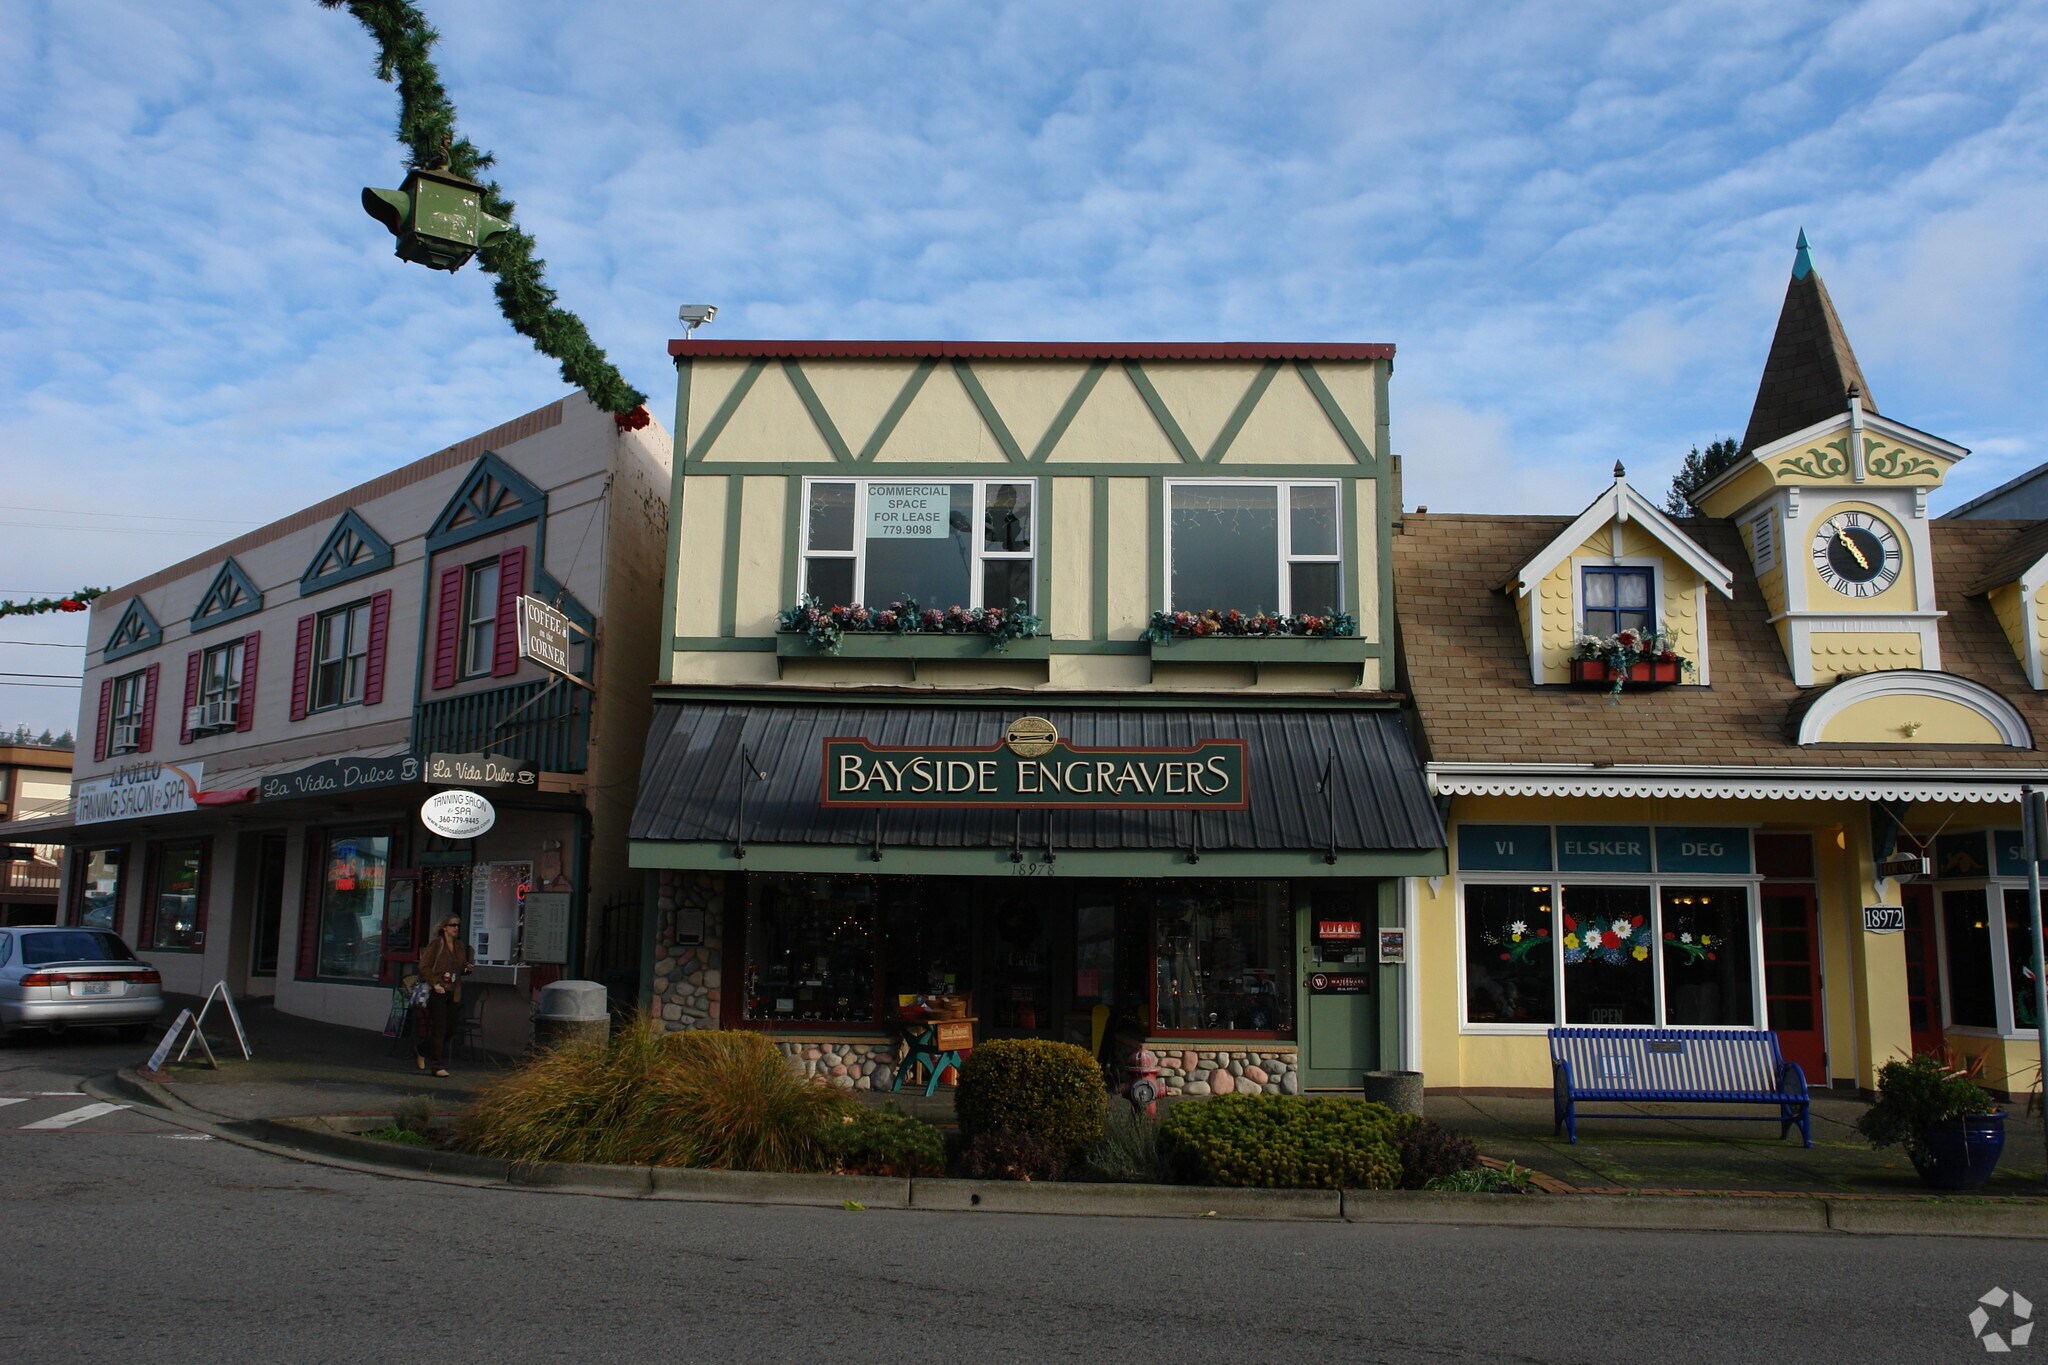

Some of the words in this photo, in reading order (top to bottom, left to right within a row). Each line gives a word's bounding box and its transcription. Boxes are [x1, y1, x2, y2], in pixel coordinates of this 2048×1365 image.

[868, 486, 948, 496] COMMERCIAL
[888, 499, 928, 509] SPACE
[874, 512, 899, 522] FOR
[902, 512, 941, 522] LEASE
[882, 525, 932, 535] 779.9098
[528, 604, 562, 635] COFFEE
[531, 635, 566, 667] CORNER
[110, 760, 161, 788] APOLLO
[432, 759, 452, 779] La
[455, 761, 482, 781] Vida
[485, 763, 515, 783] Dulce
[838, 754, 999, 794] BAYSIDE
[1017, 755, 1230, 796] ENGRAVERS
[264, 778, 290, 798] La
[295, 774, 337, 793] Vida
[343, 766, 396, 787] Dulce
[80, 790, 119, 821] TANNING
[120, 784, 154, 815] SALON
[163, 779, 185, 810] SPA
[434, 794, 464, 808] TANNING
[465, 795, 487, 812] SALON
[455, 807, 471, 815] SPA
[439, 815, 480, 825] 360-779-9445
[1495, 841, 1514, 855] VI
[1564, 841, 1642, 856] ELSKER
[1681, 842, 1724, 857] DEG
[1011, 862, 1056, 876] 18978
[1865, 909, 1903, 928] 18972
[1591, 1008, 1623, 1024] OPEN
